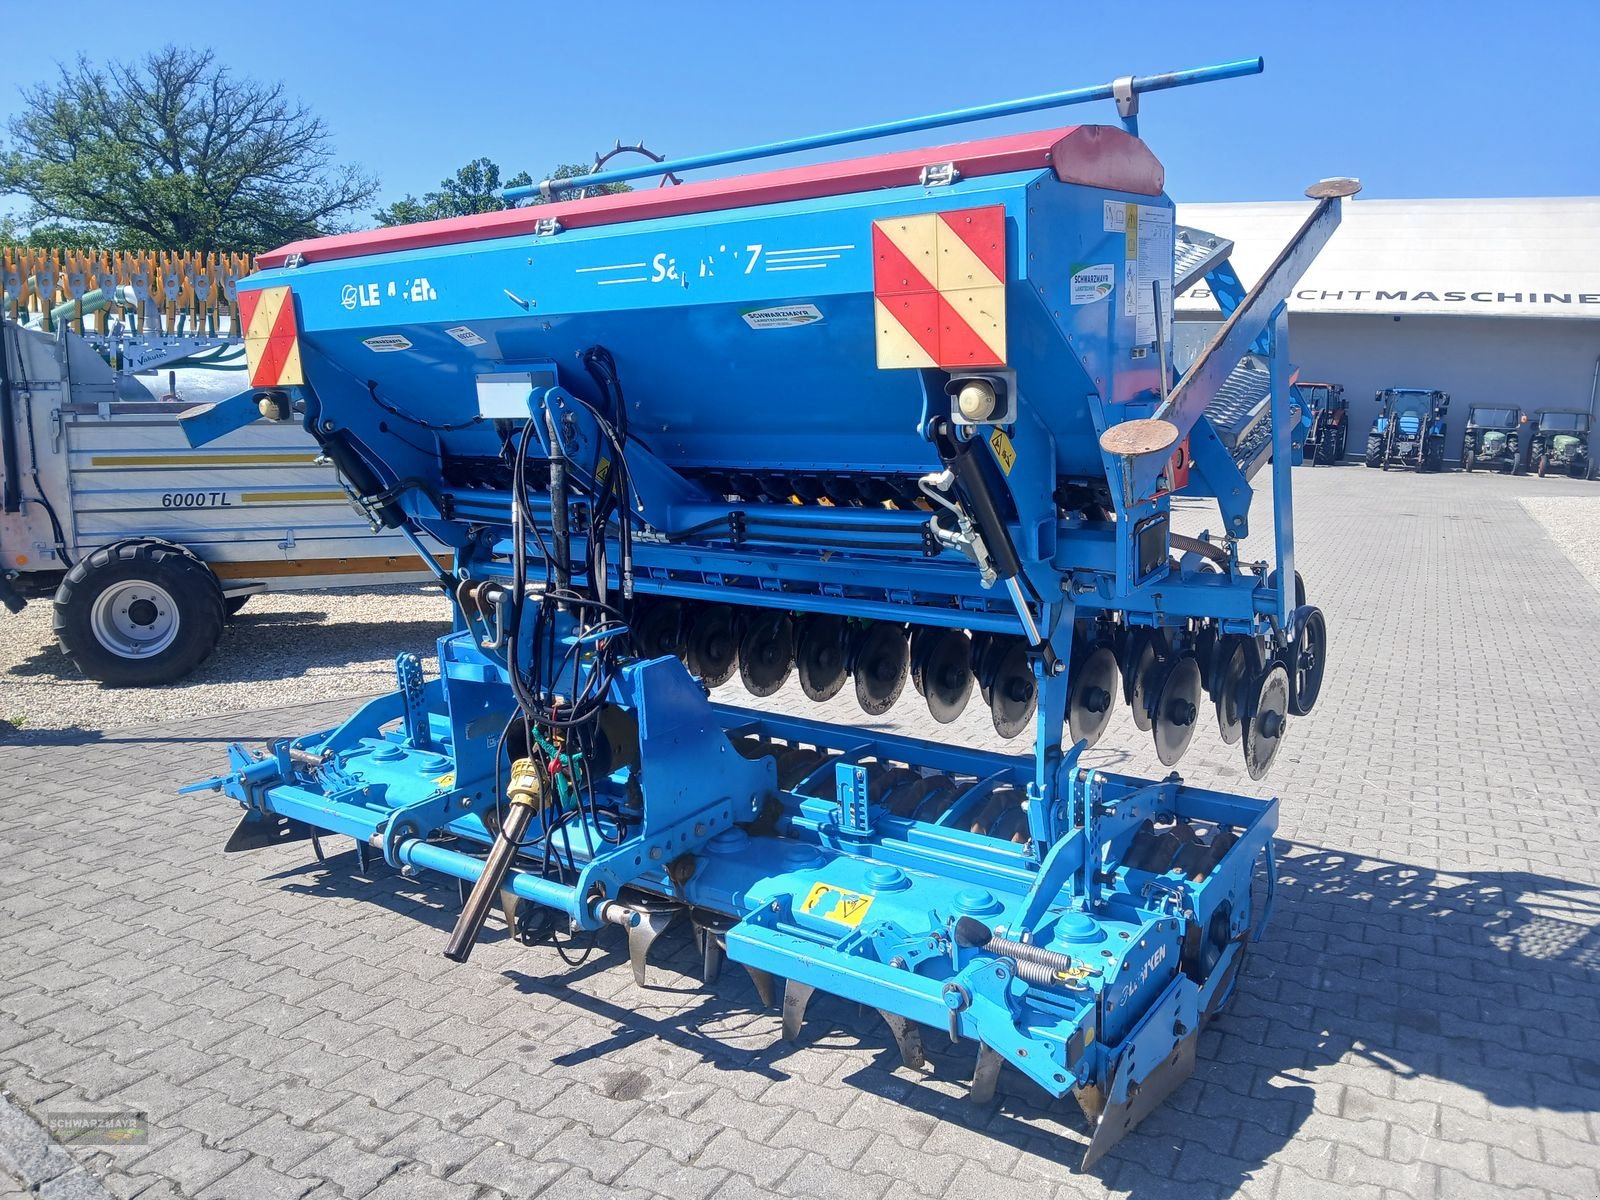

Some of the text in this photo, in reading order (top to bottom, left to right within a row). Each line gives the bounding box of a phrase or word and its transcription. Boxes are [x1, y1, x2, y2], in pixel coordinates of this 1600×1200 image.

[744, 244, 763, 275] 7
[747, 310, 809, 319] SCHWARZMAYR
[162, 492, 232, 507] 6000 TL
